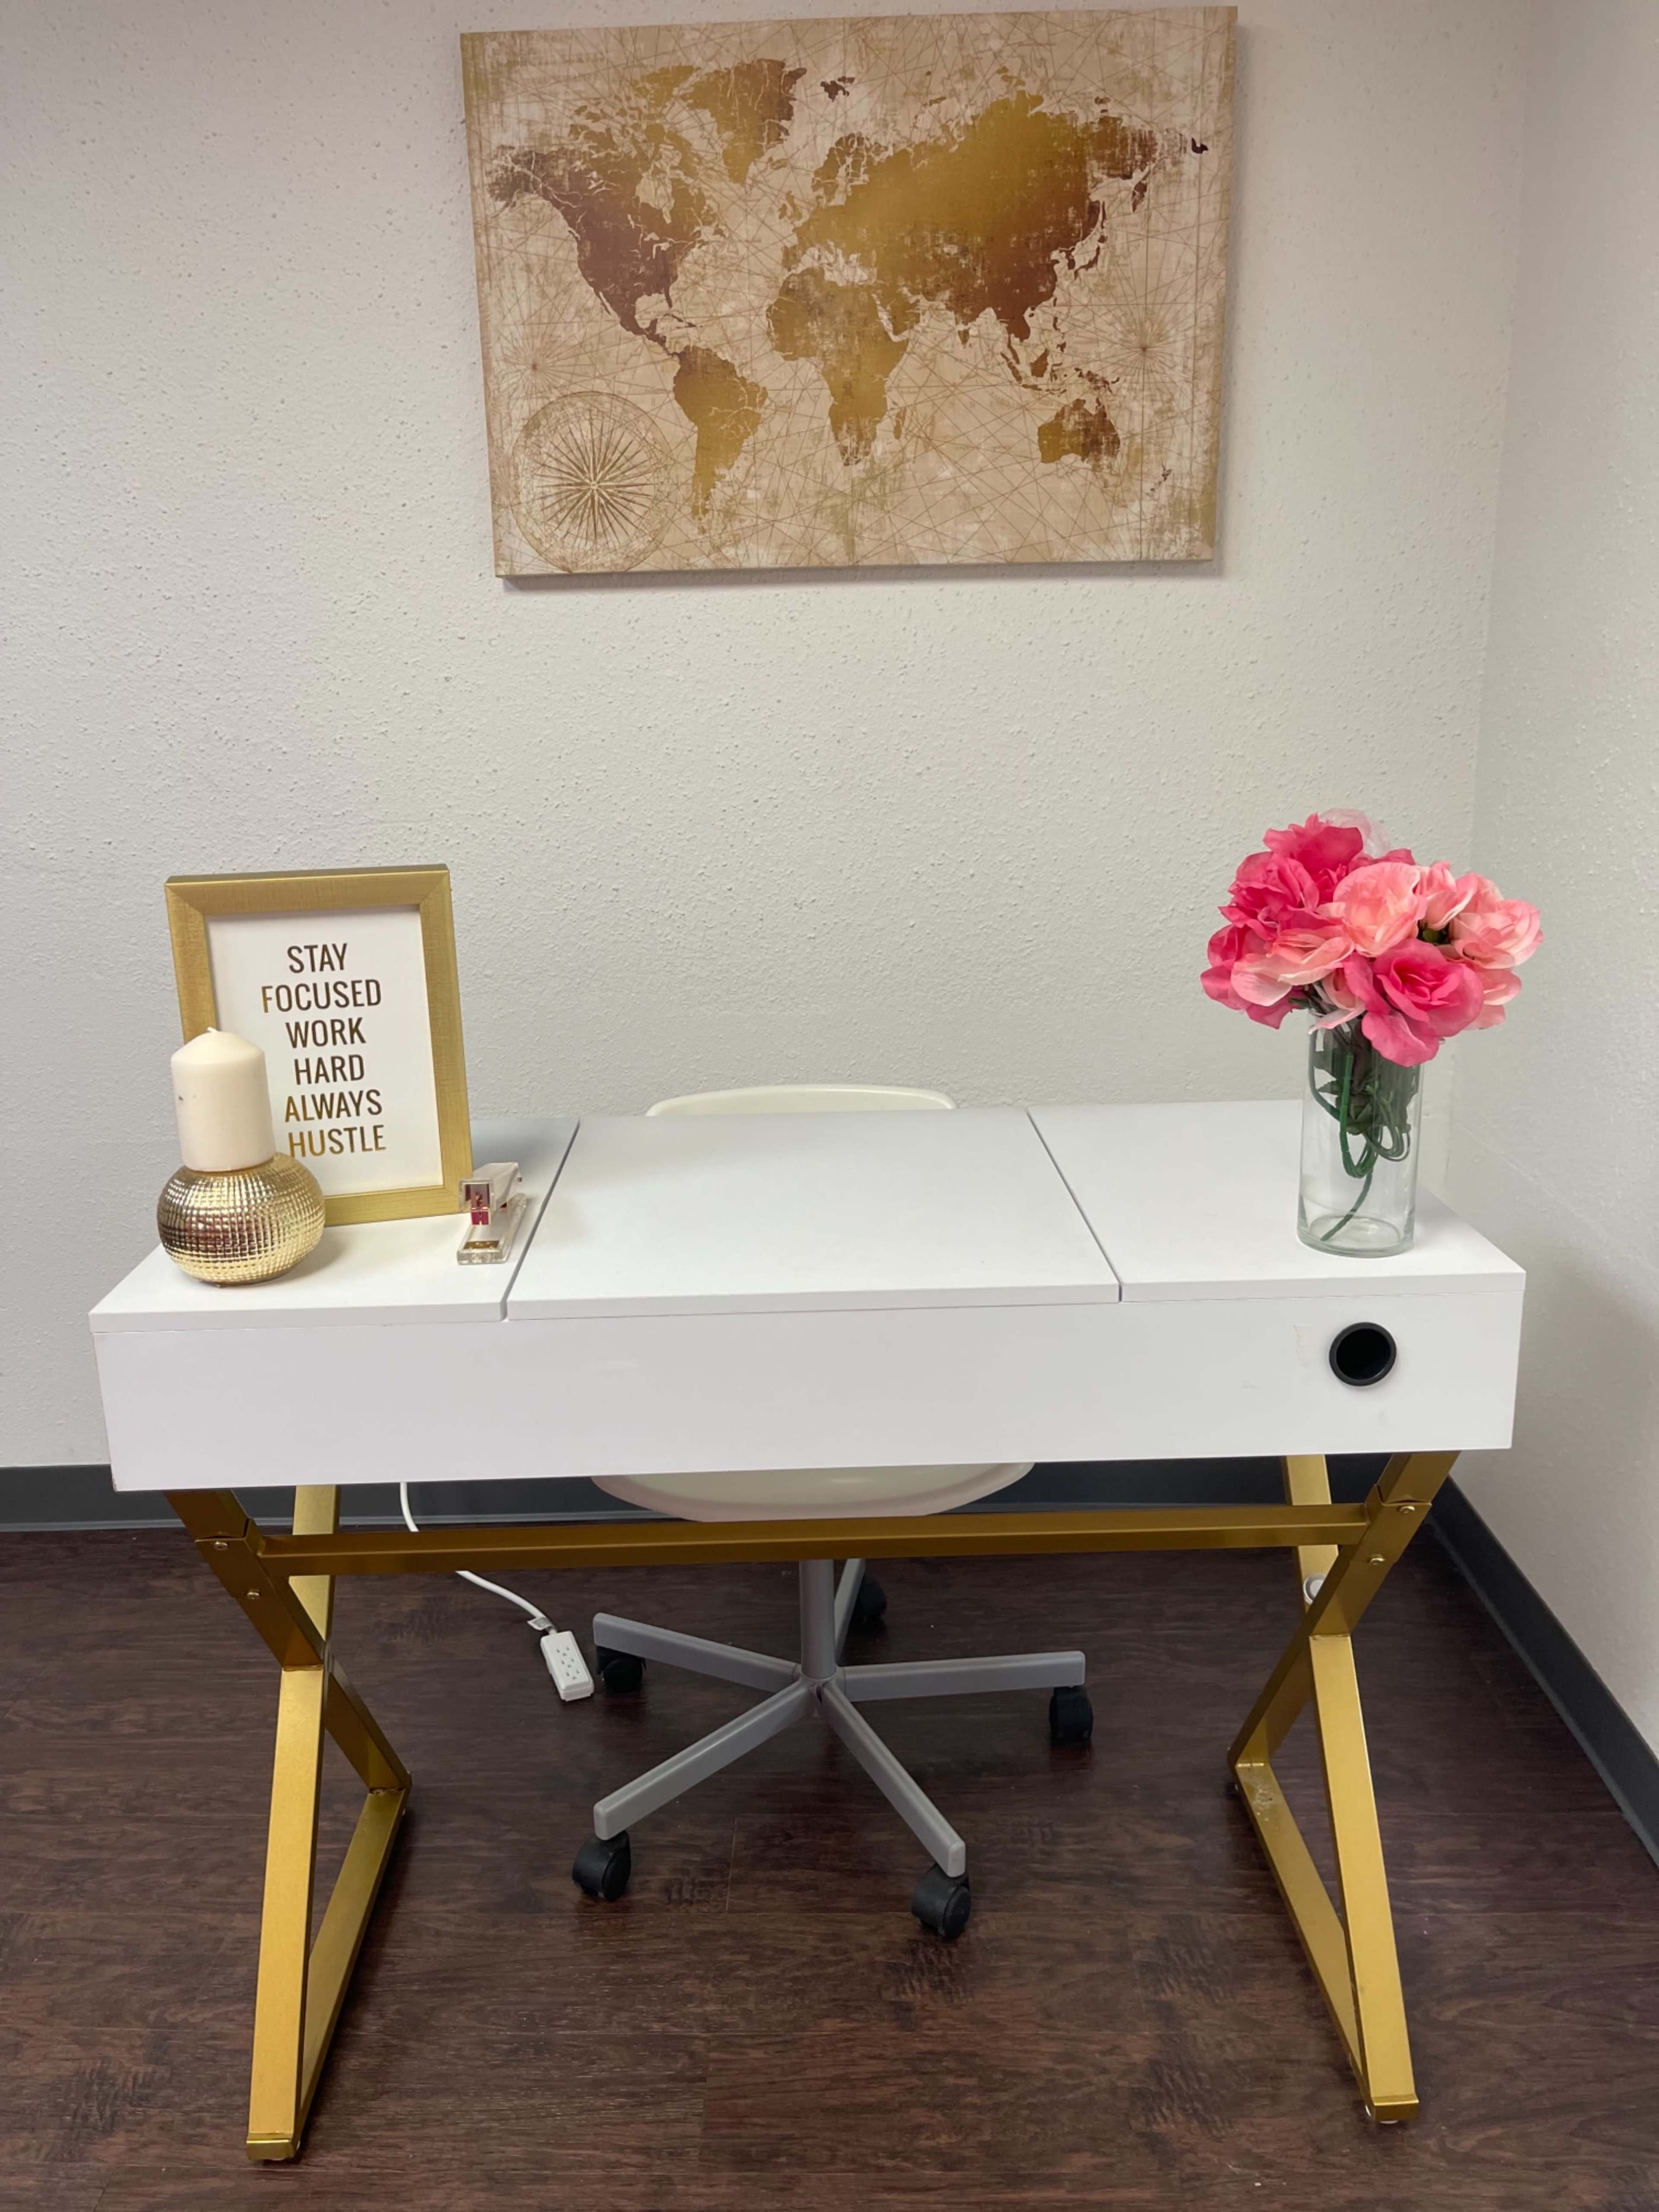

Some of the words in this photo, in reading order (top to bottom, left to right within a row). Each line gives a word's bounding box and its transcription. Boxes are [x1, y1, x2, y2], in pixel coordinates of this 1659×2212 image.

[287, 942, 347, 974] STAY
[261, 979, 381, 1014] FOCUSED
[285, 1017, 366, 1049] WORK
[294, 1054, 365, 1086] HARD
[285, 1089, 382, 1122] ALWAYS
[288, 1124, 386, 1158] HUSTLE
